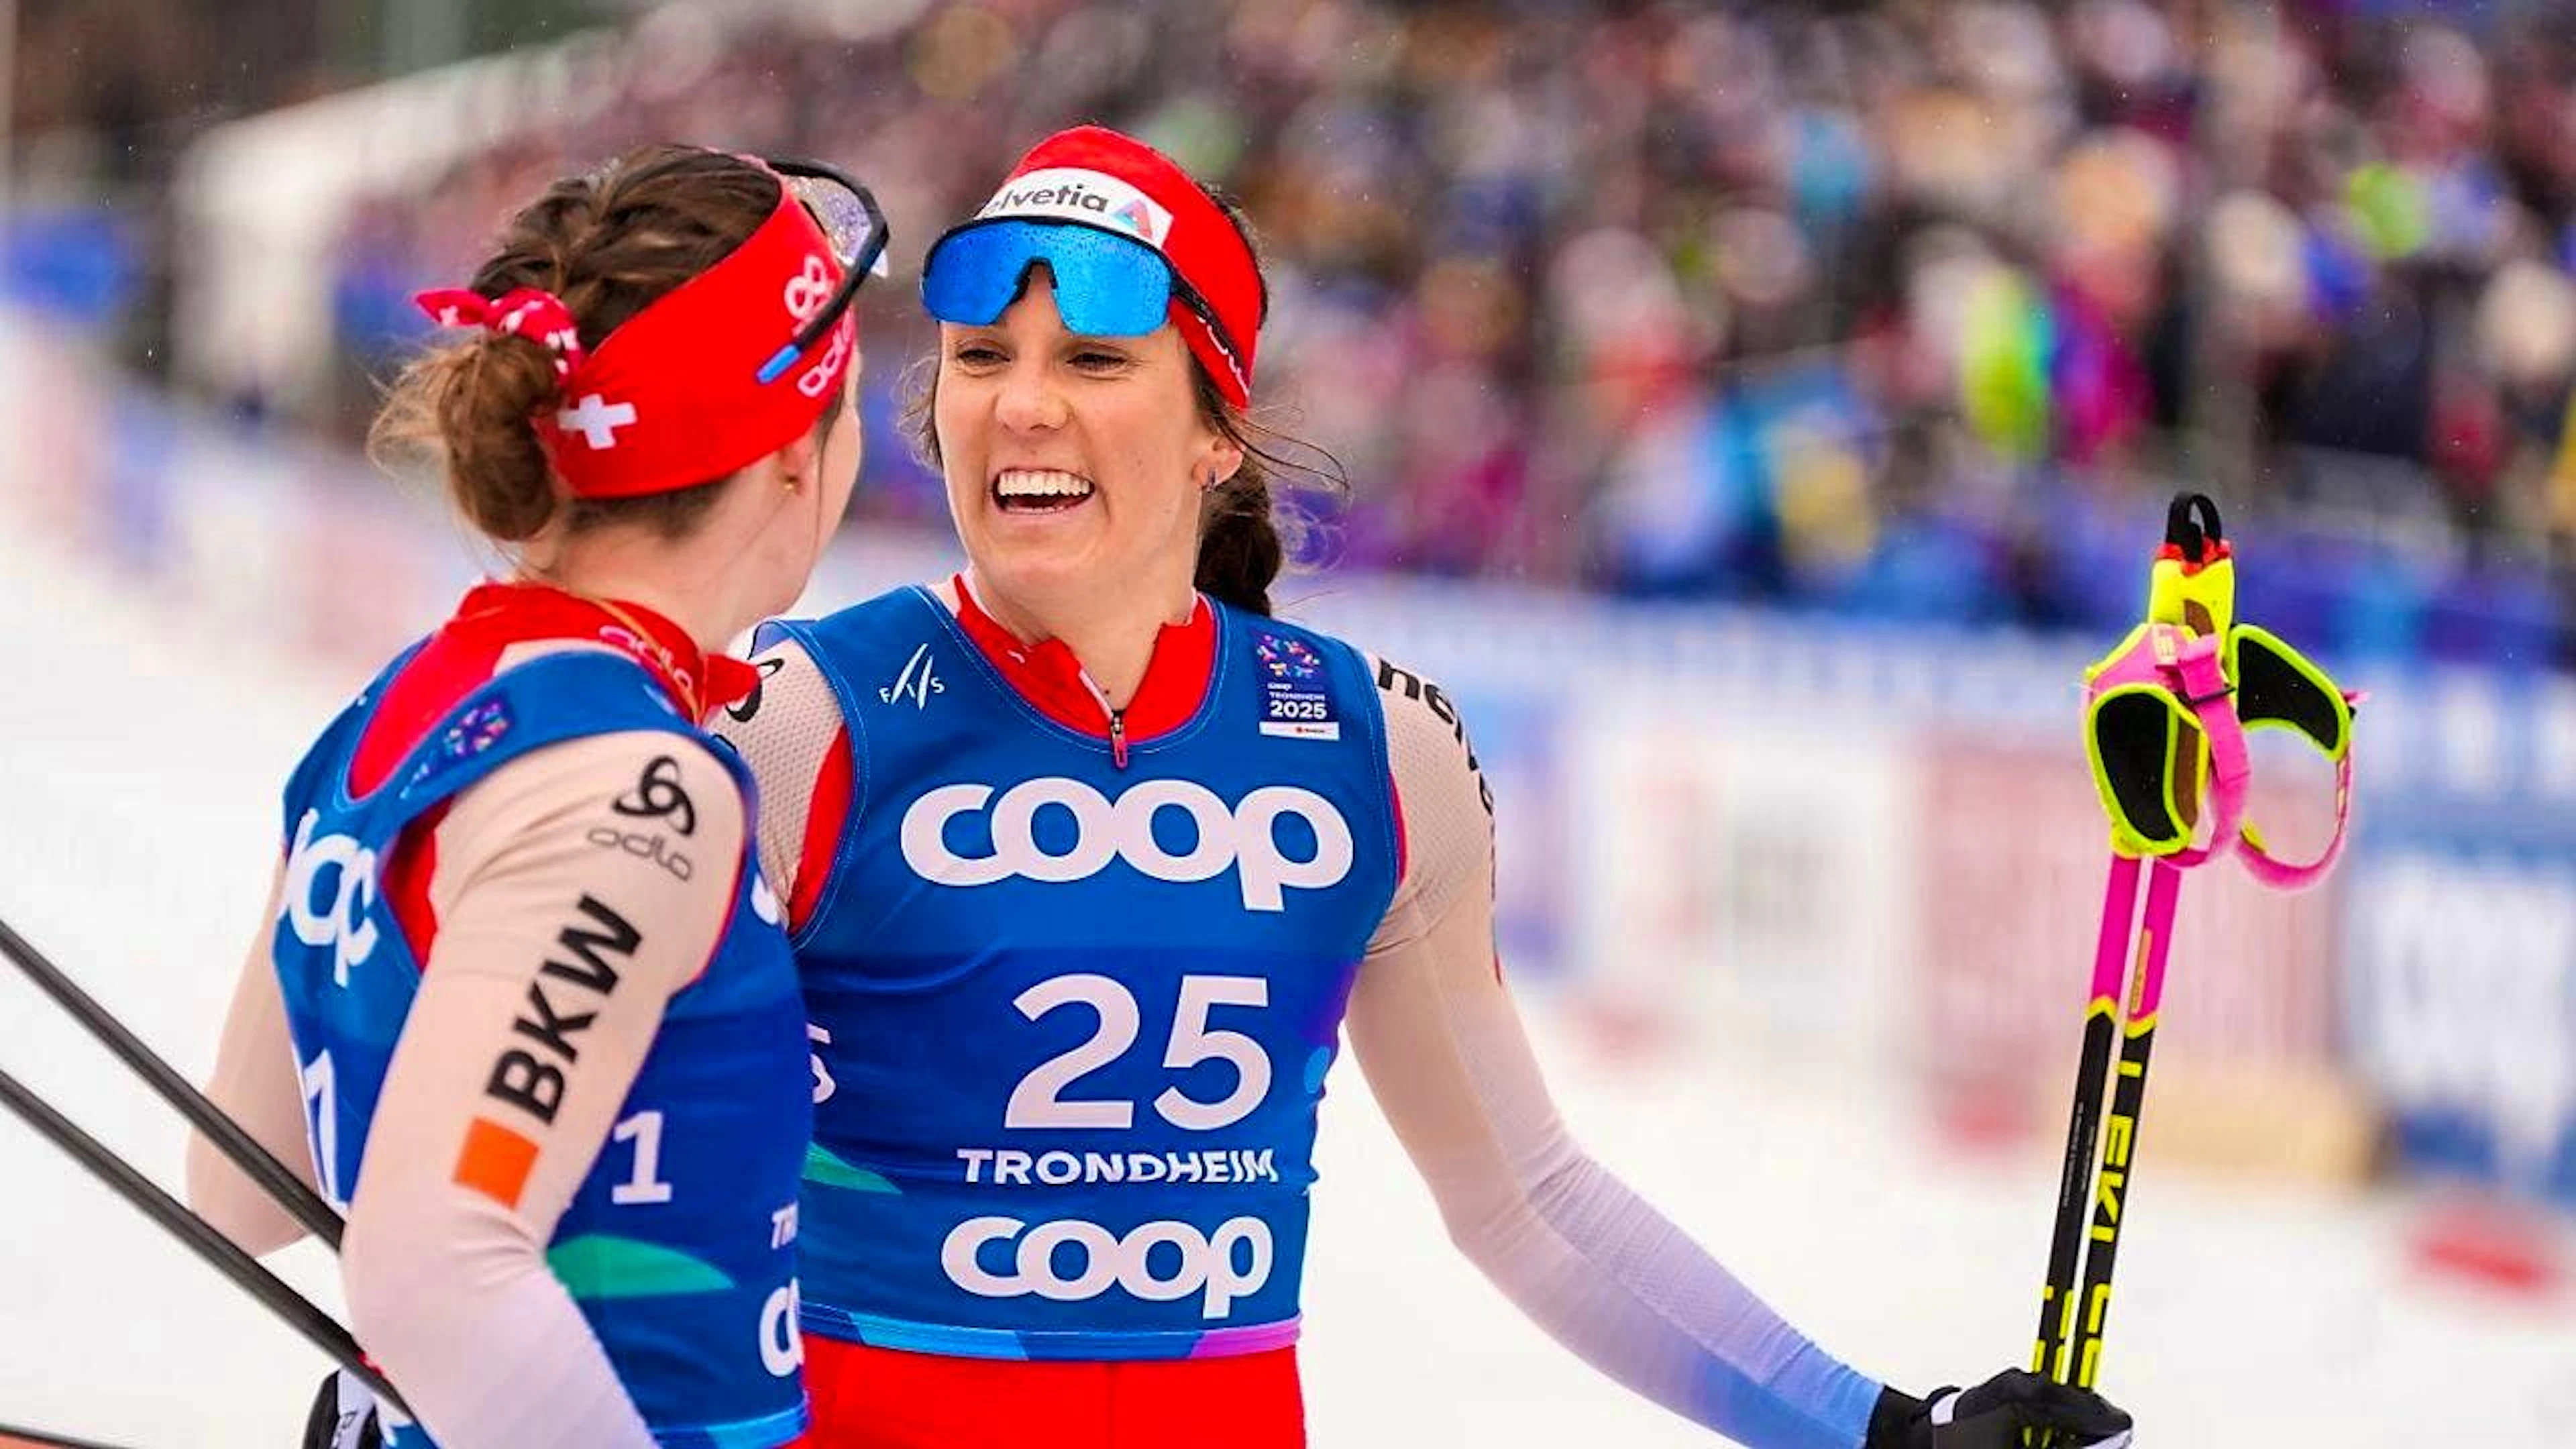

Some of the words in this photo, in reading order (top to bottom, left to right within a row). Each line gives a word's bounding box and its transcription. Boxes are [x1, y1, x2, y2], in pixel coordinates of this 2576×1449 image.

[1270, 699, 1328, 720] 2025
[586, 826, 693, 882] odlo
[900, 777, 1354, 911] coop
[485, 893, 644, 1128] BKW
[1005, 973, 1273, 1130] 25
[957, 1148, 1279, 1185] TRONDHEIM
[941, 1216, 1274, 1320] coop
